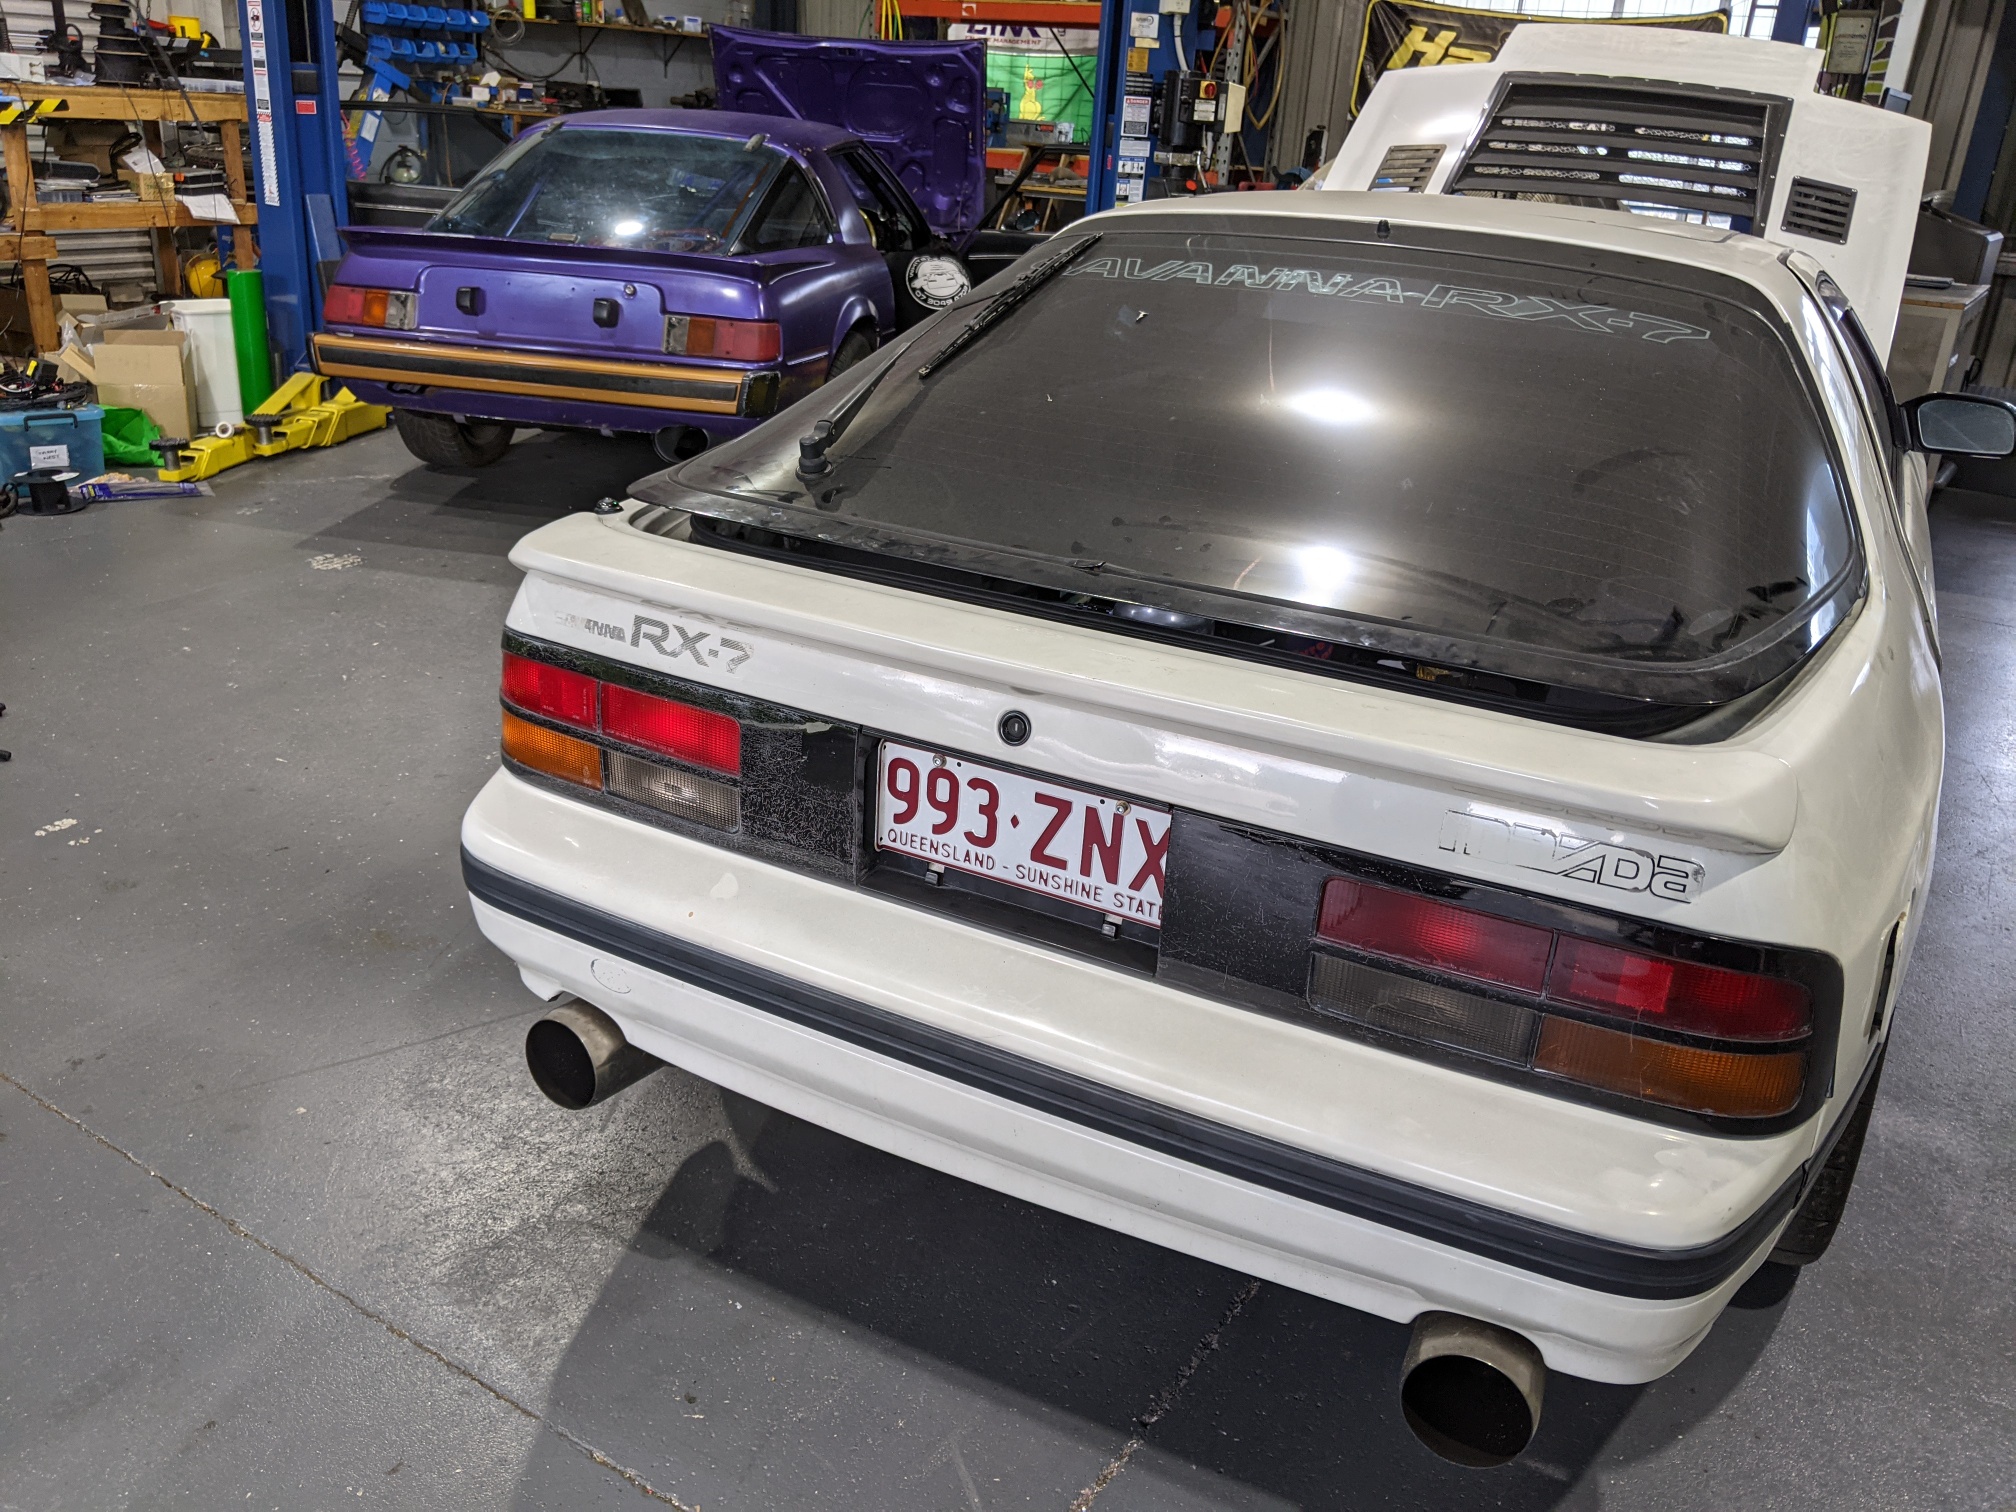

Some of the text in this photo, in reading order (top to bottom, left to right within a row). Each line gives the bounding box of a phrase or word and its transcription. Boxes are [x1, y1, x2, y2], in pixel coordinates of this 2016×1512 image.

[1062, 256, 1404, 304] AVANNA
[630, 614, 755, 675] RX-7
[887, 828, 996, 871] QUEENSLAND
[1015, 864, 1103, 900] SUNSHINE
